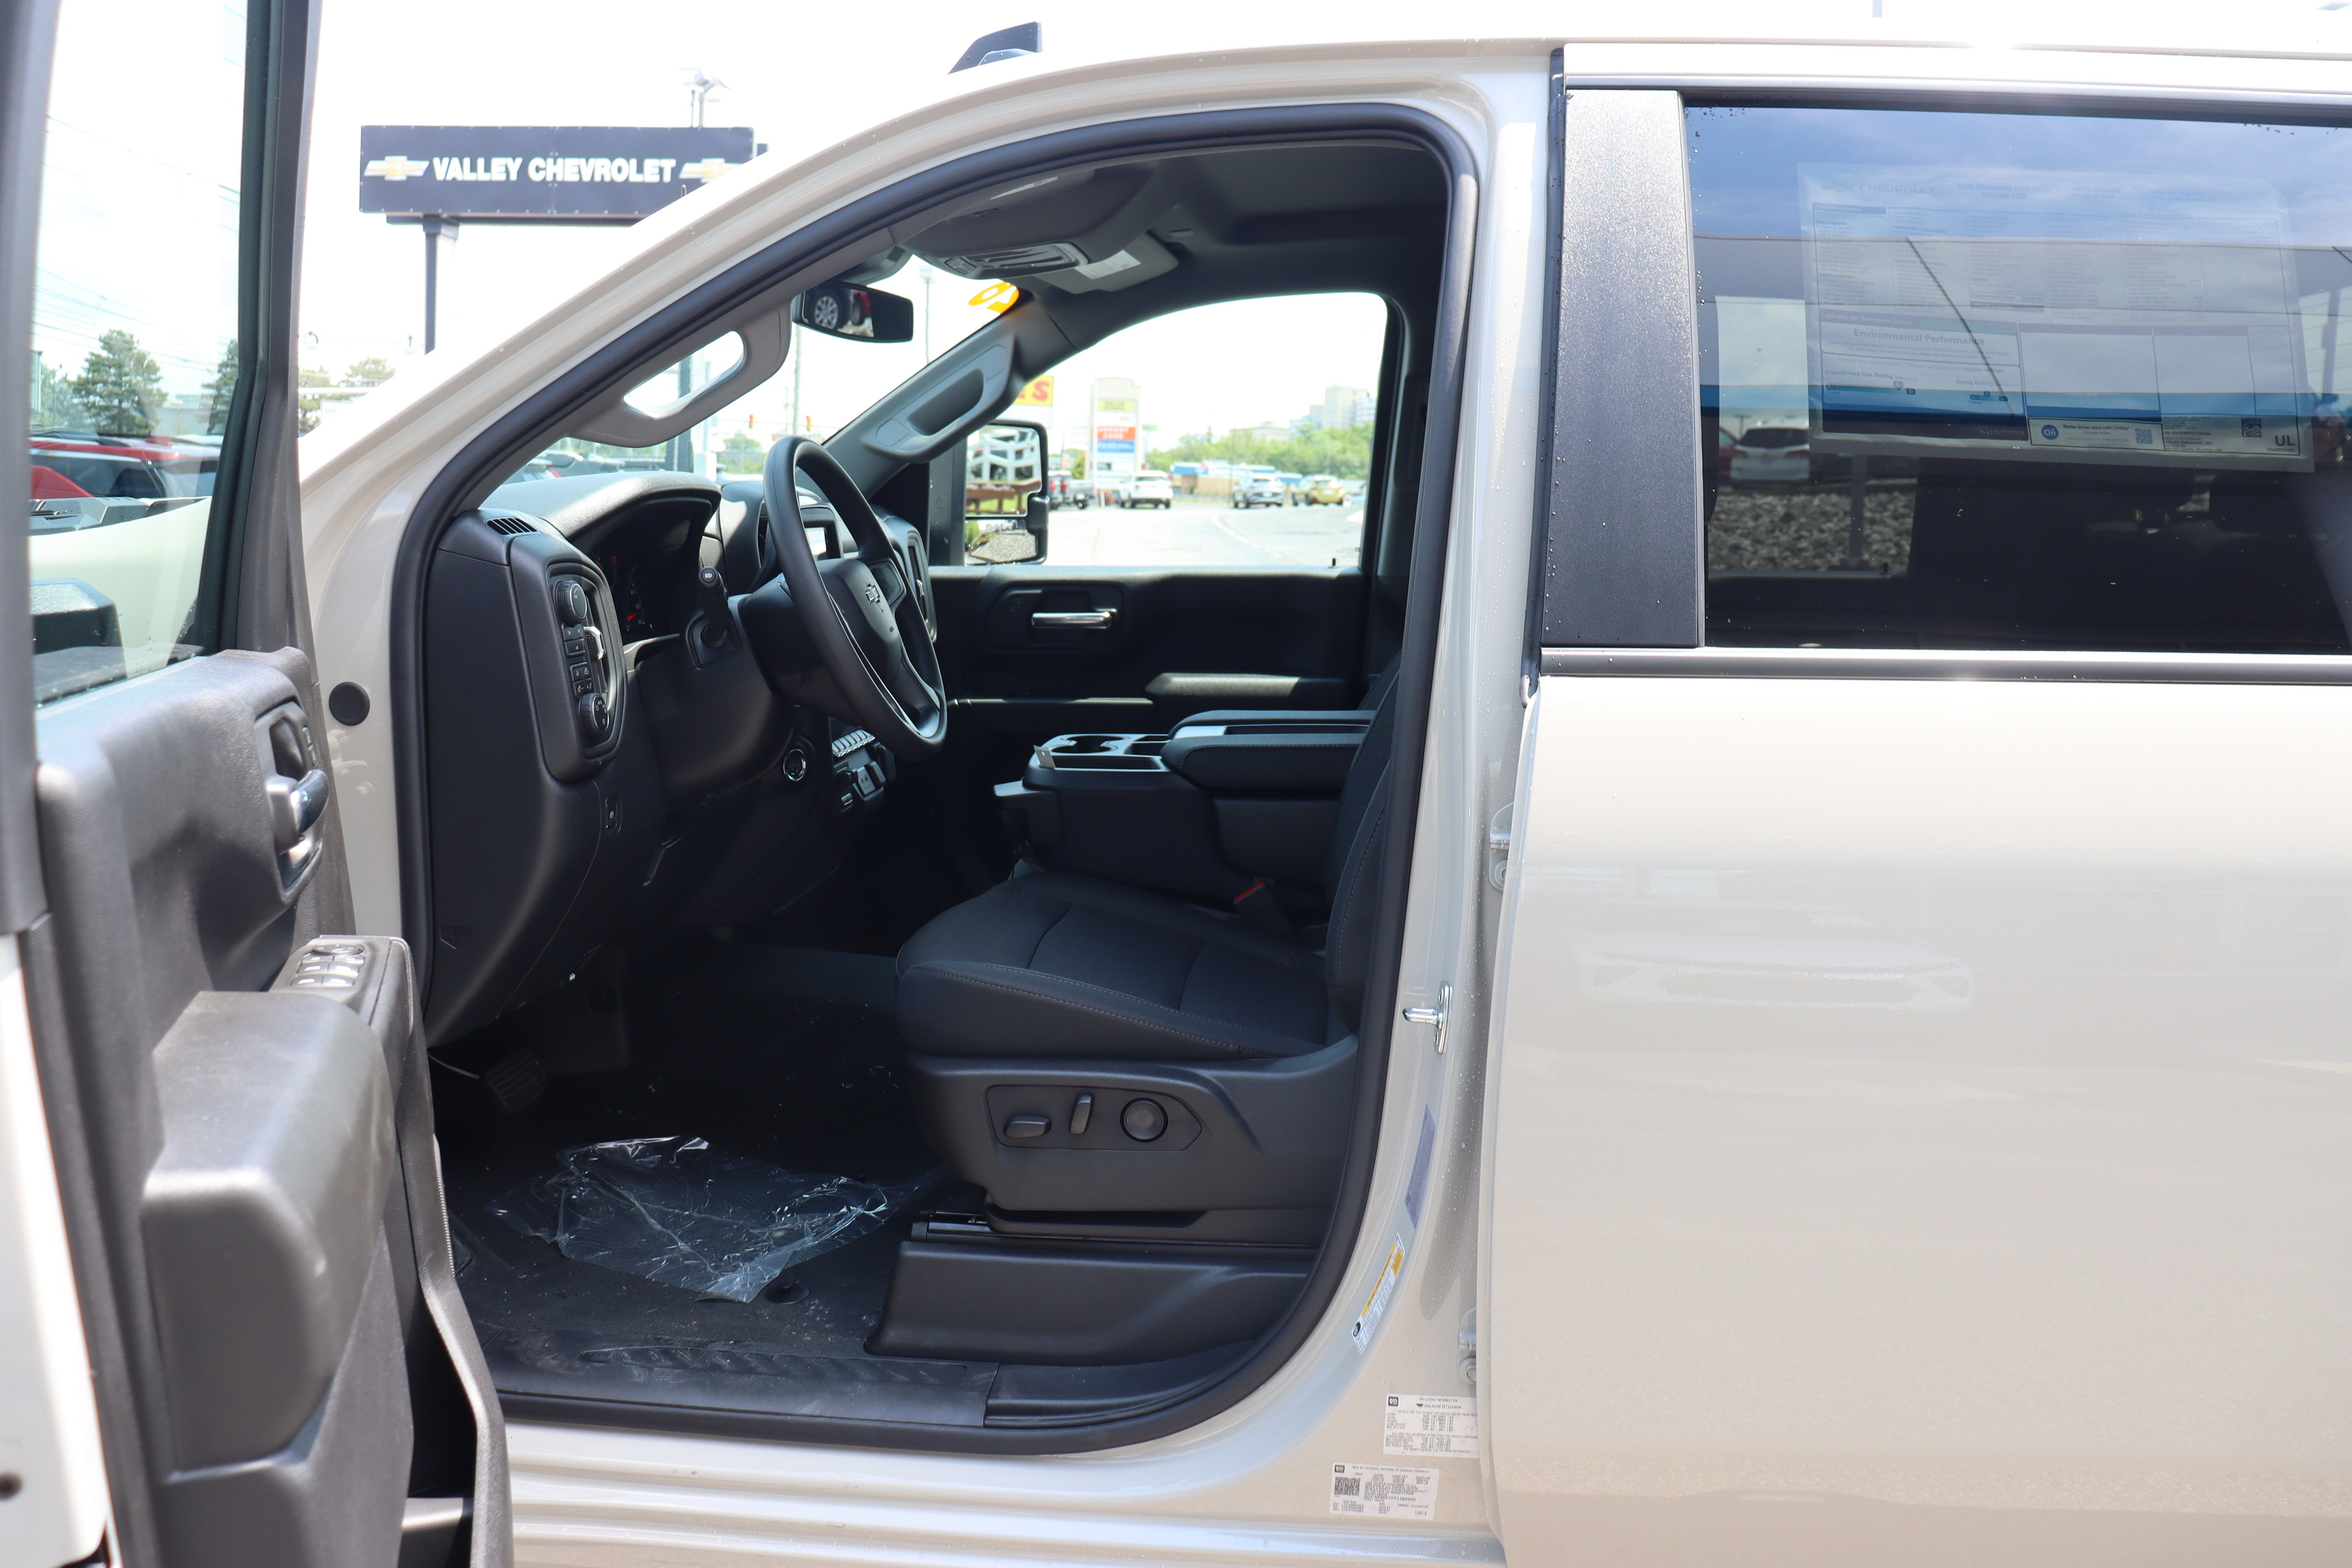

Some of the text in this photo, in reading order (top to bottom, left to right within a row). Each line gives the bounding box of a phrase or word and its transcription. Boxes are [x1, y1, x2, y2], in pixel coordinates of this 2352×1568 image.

[432, 156, 676, 183] VALLEY CHEVROLET
[1860, 183, 1933, 194] CHEVROLET
[1854, 329, 1922, 341] Environmental
[2275, 435, 2296, 446] UL
